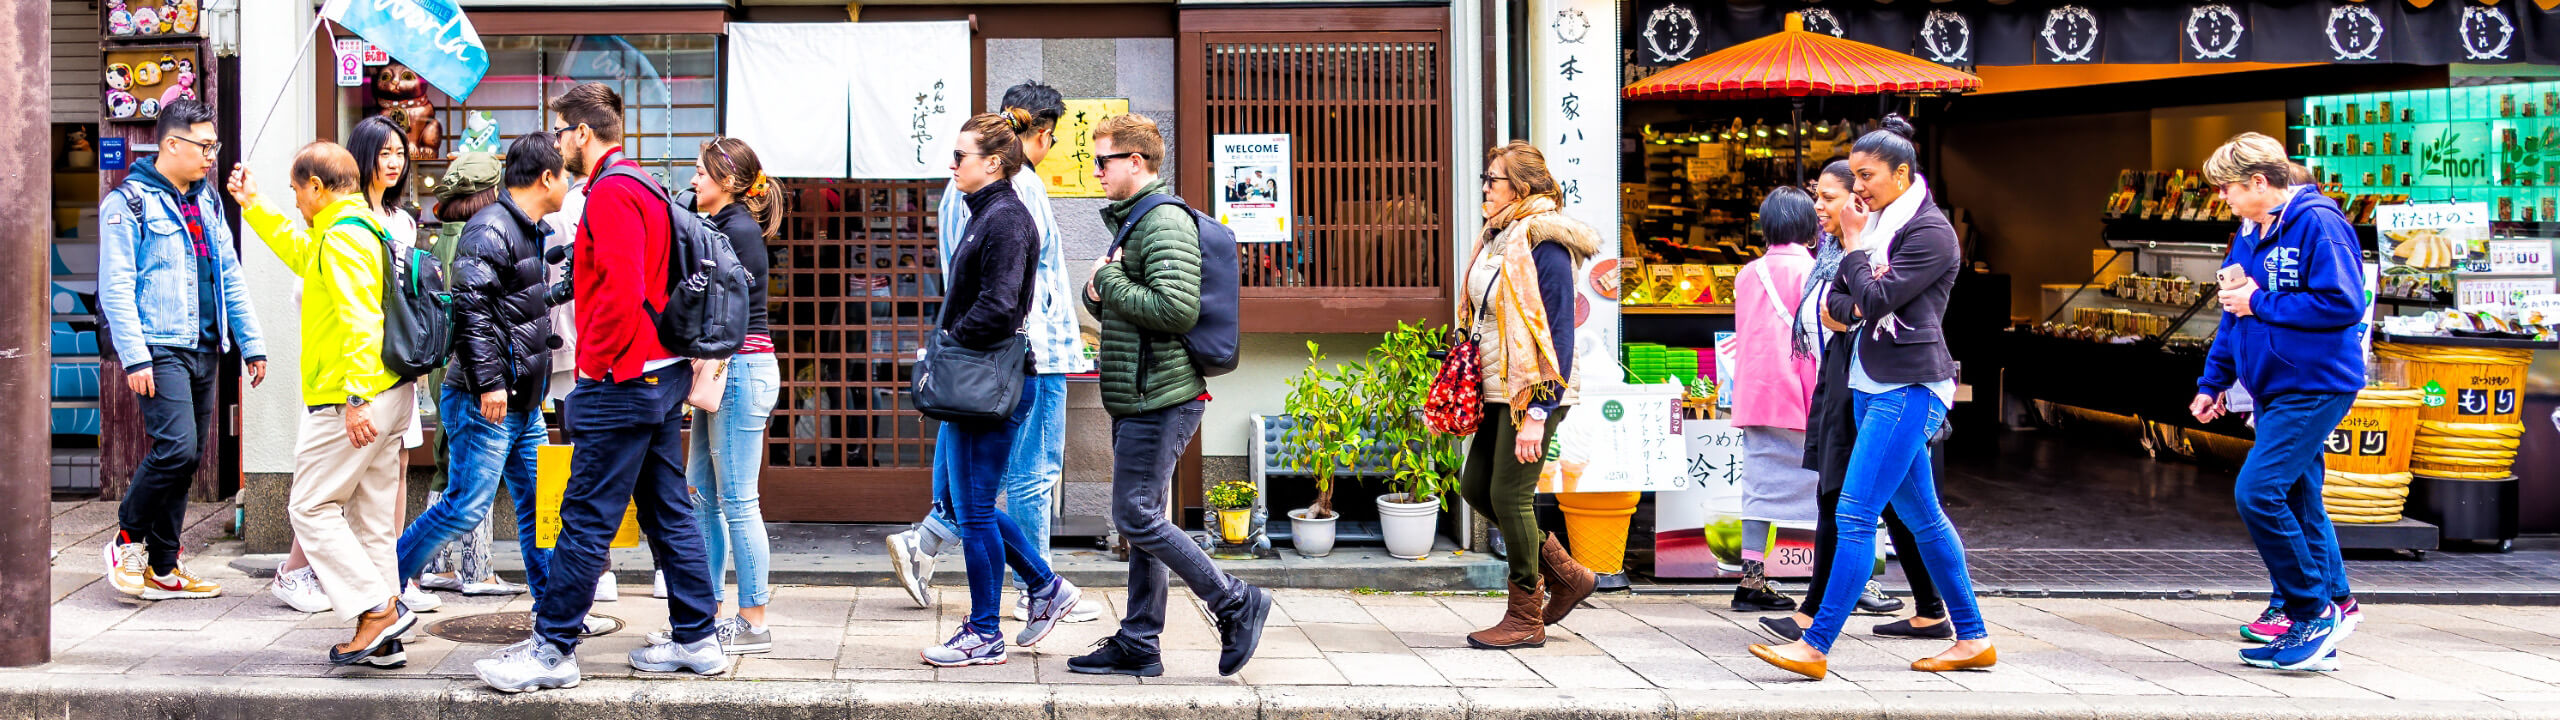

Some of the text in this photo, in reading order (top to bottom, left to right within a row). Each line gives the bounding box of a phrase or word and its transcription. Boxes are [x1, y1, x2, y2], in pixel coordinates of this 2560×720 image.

[1225, 144, 1279, 152] WELCOME
[2443, 154, 2485, 178] mori
[2279, 247, 2299, 287] CAPE
[2458, 388, 2513, 414] もり
[1640, 402, 1654, 486] ソフトクリーム
[1780, 547, 1812, 565] 350
